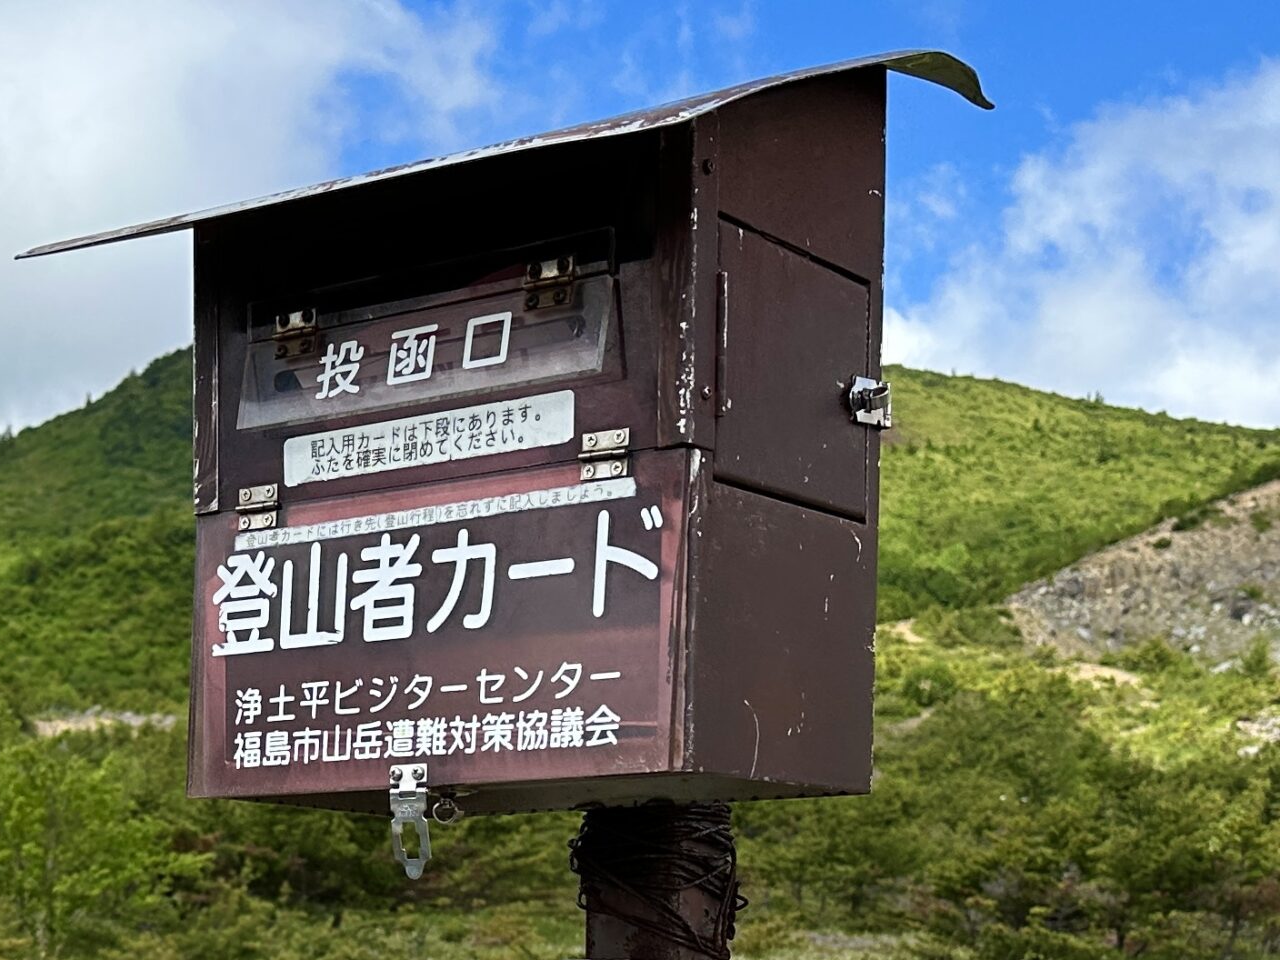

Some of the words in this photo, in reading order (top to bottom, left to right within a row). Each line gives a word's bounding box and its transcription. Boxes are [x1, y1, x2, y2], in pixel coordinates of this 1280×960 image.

[315, 311, 513, 400] 投函口
[310, 403, 542, 459] 記入用カードは下段にあります。
[310, 429, 524, 475] ふたを確実に閉めてください。
[211, 505, 664, 657] 登山者カード
[235, 661, 621, 726] 浄土平ビジターセンター
[233, 704, 621, 770] 福島市山岳遭難対策協議会
